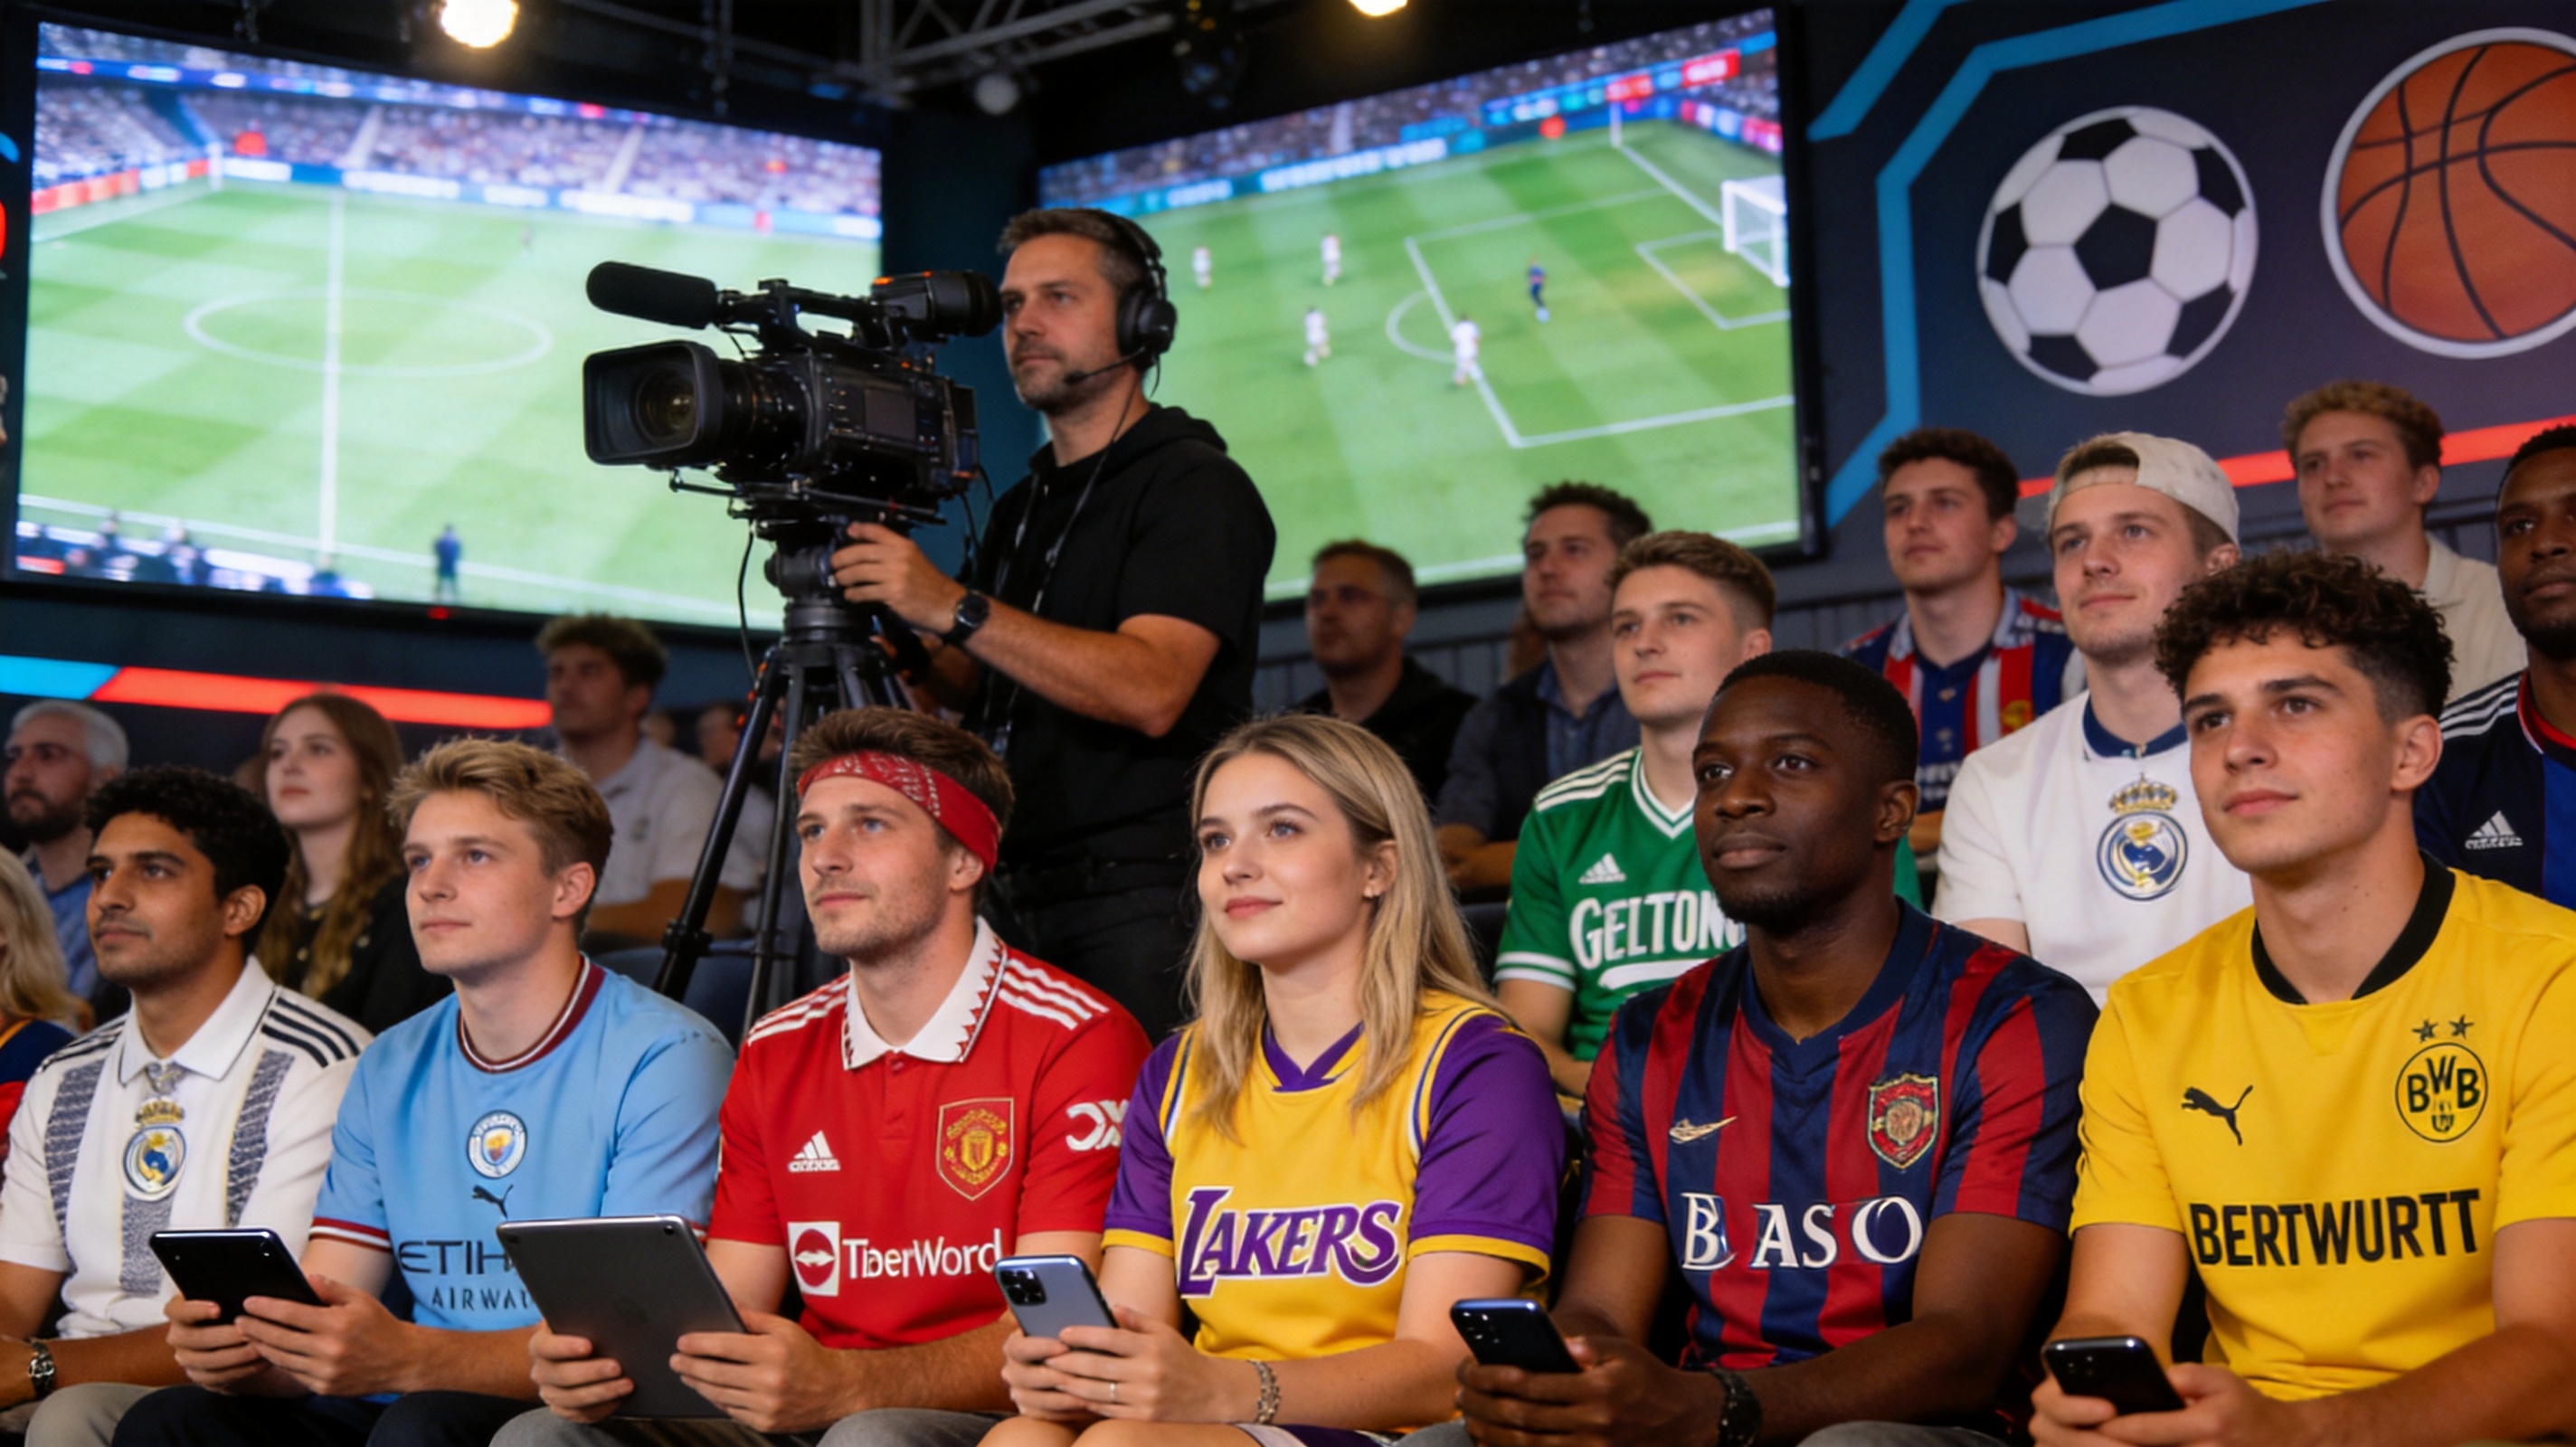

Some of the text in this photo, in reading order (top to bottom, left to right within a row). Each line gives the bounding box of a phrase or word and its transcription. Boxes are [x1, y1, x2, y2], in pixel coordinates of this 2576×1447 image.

[398, 1240, 511, 1274] ETIH
[1178, 1186, 1403, 1299] LAKERS
[2189, 1188, 2480, 1266] BERTWURTT
